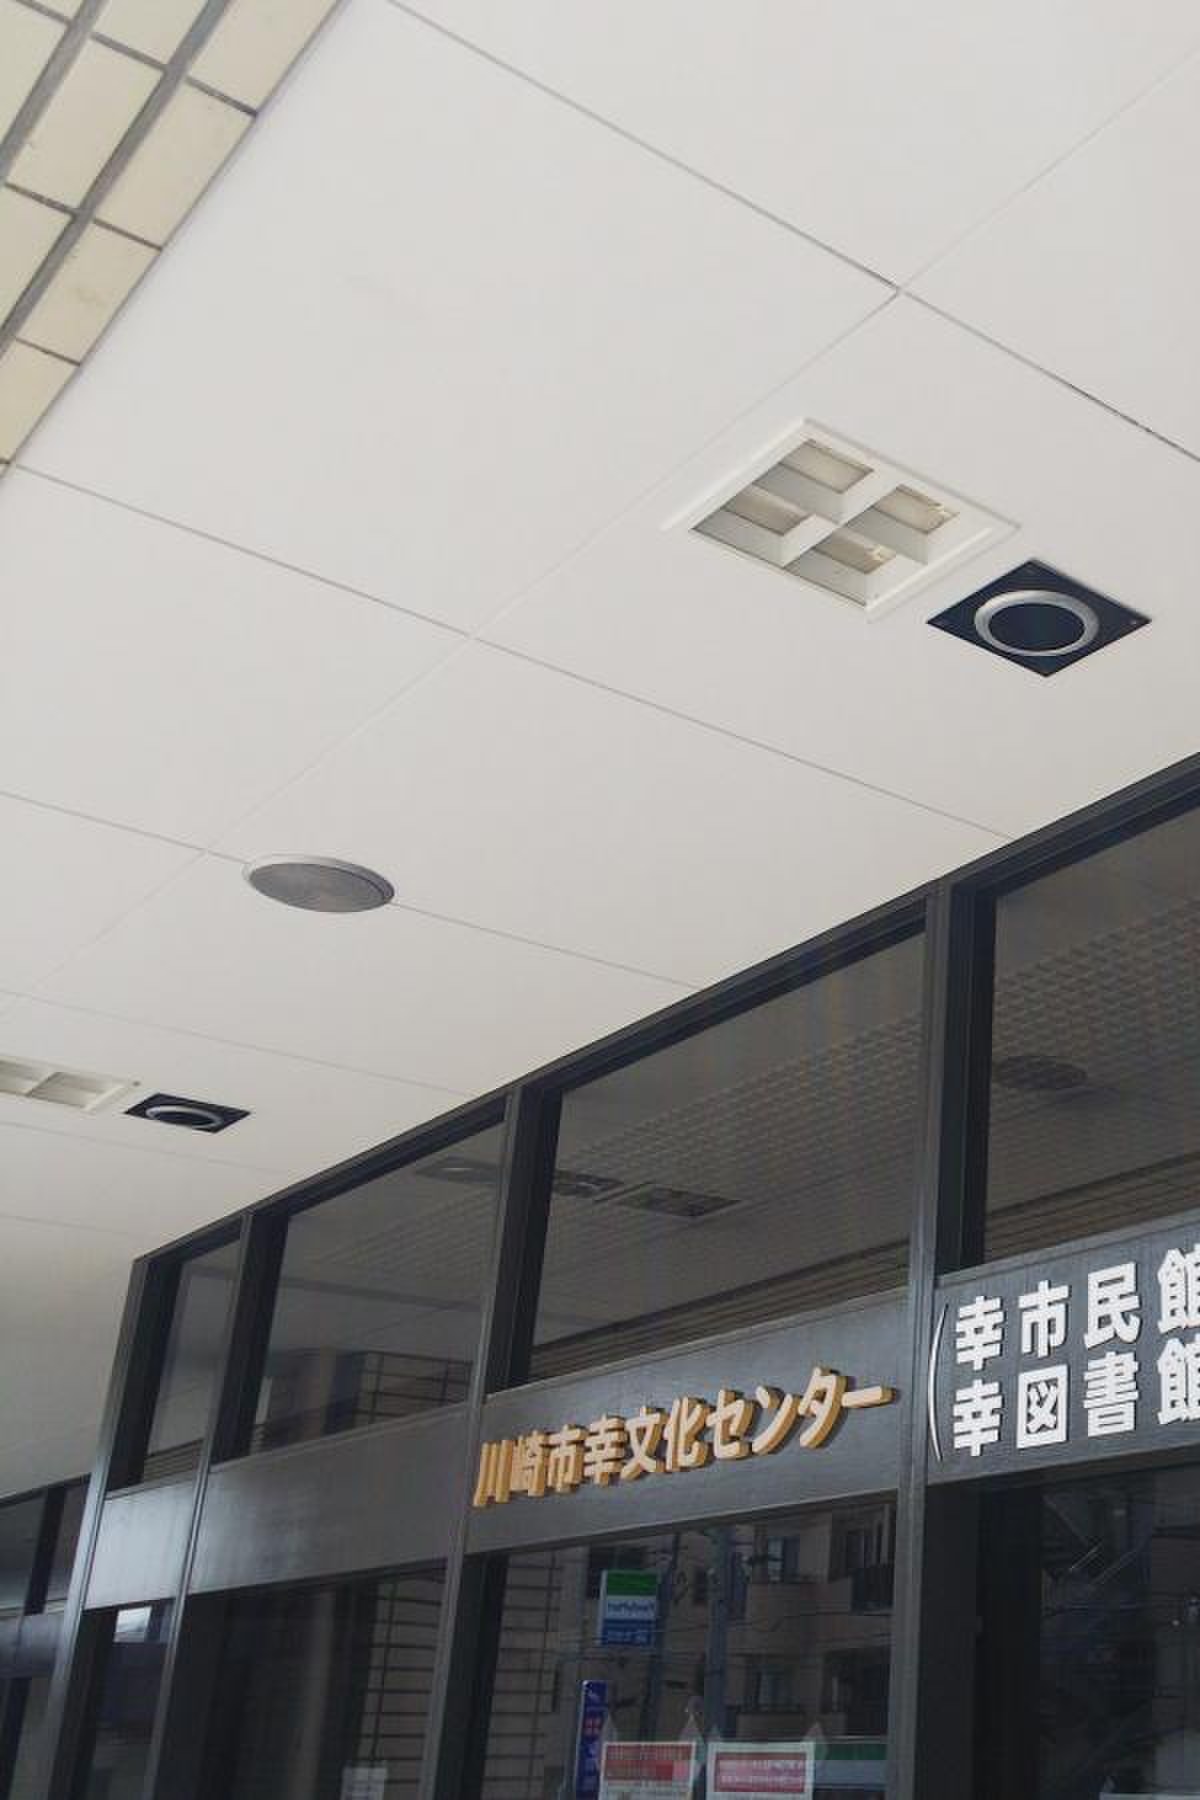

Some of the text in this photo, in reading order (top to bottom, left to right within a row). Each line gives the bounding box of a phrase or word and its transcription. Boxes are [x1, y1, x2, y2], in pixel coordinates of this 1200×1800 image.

[473, 1366, 894, 1507] 川崎市幸文化センター
